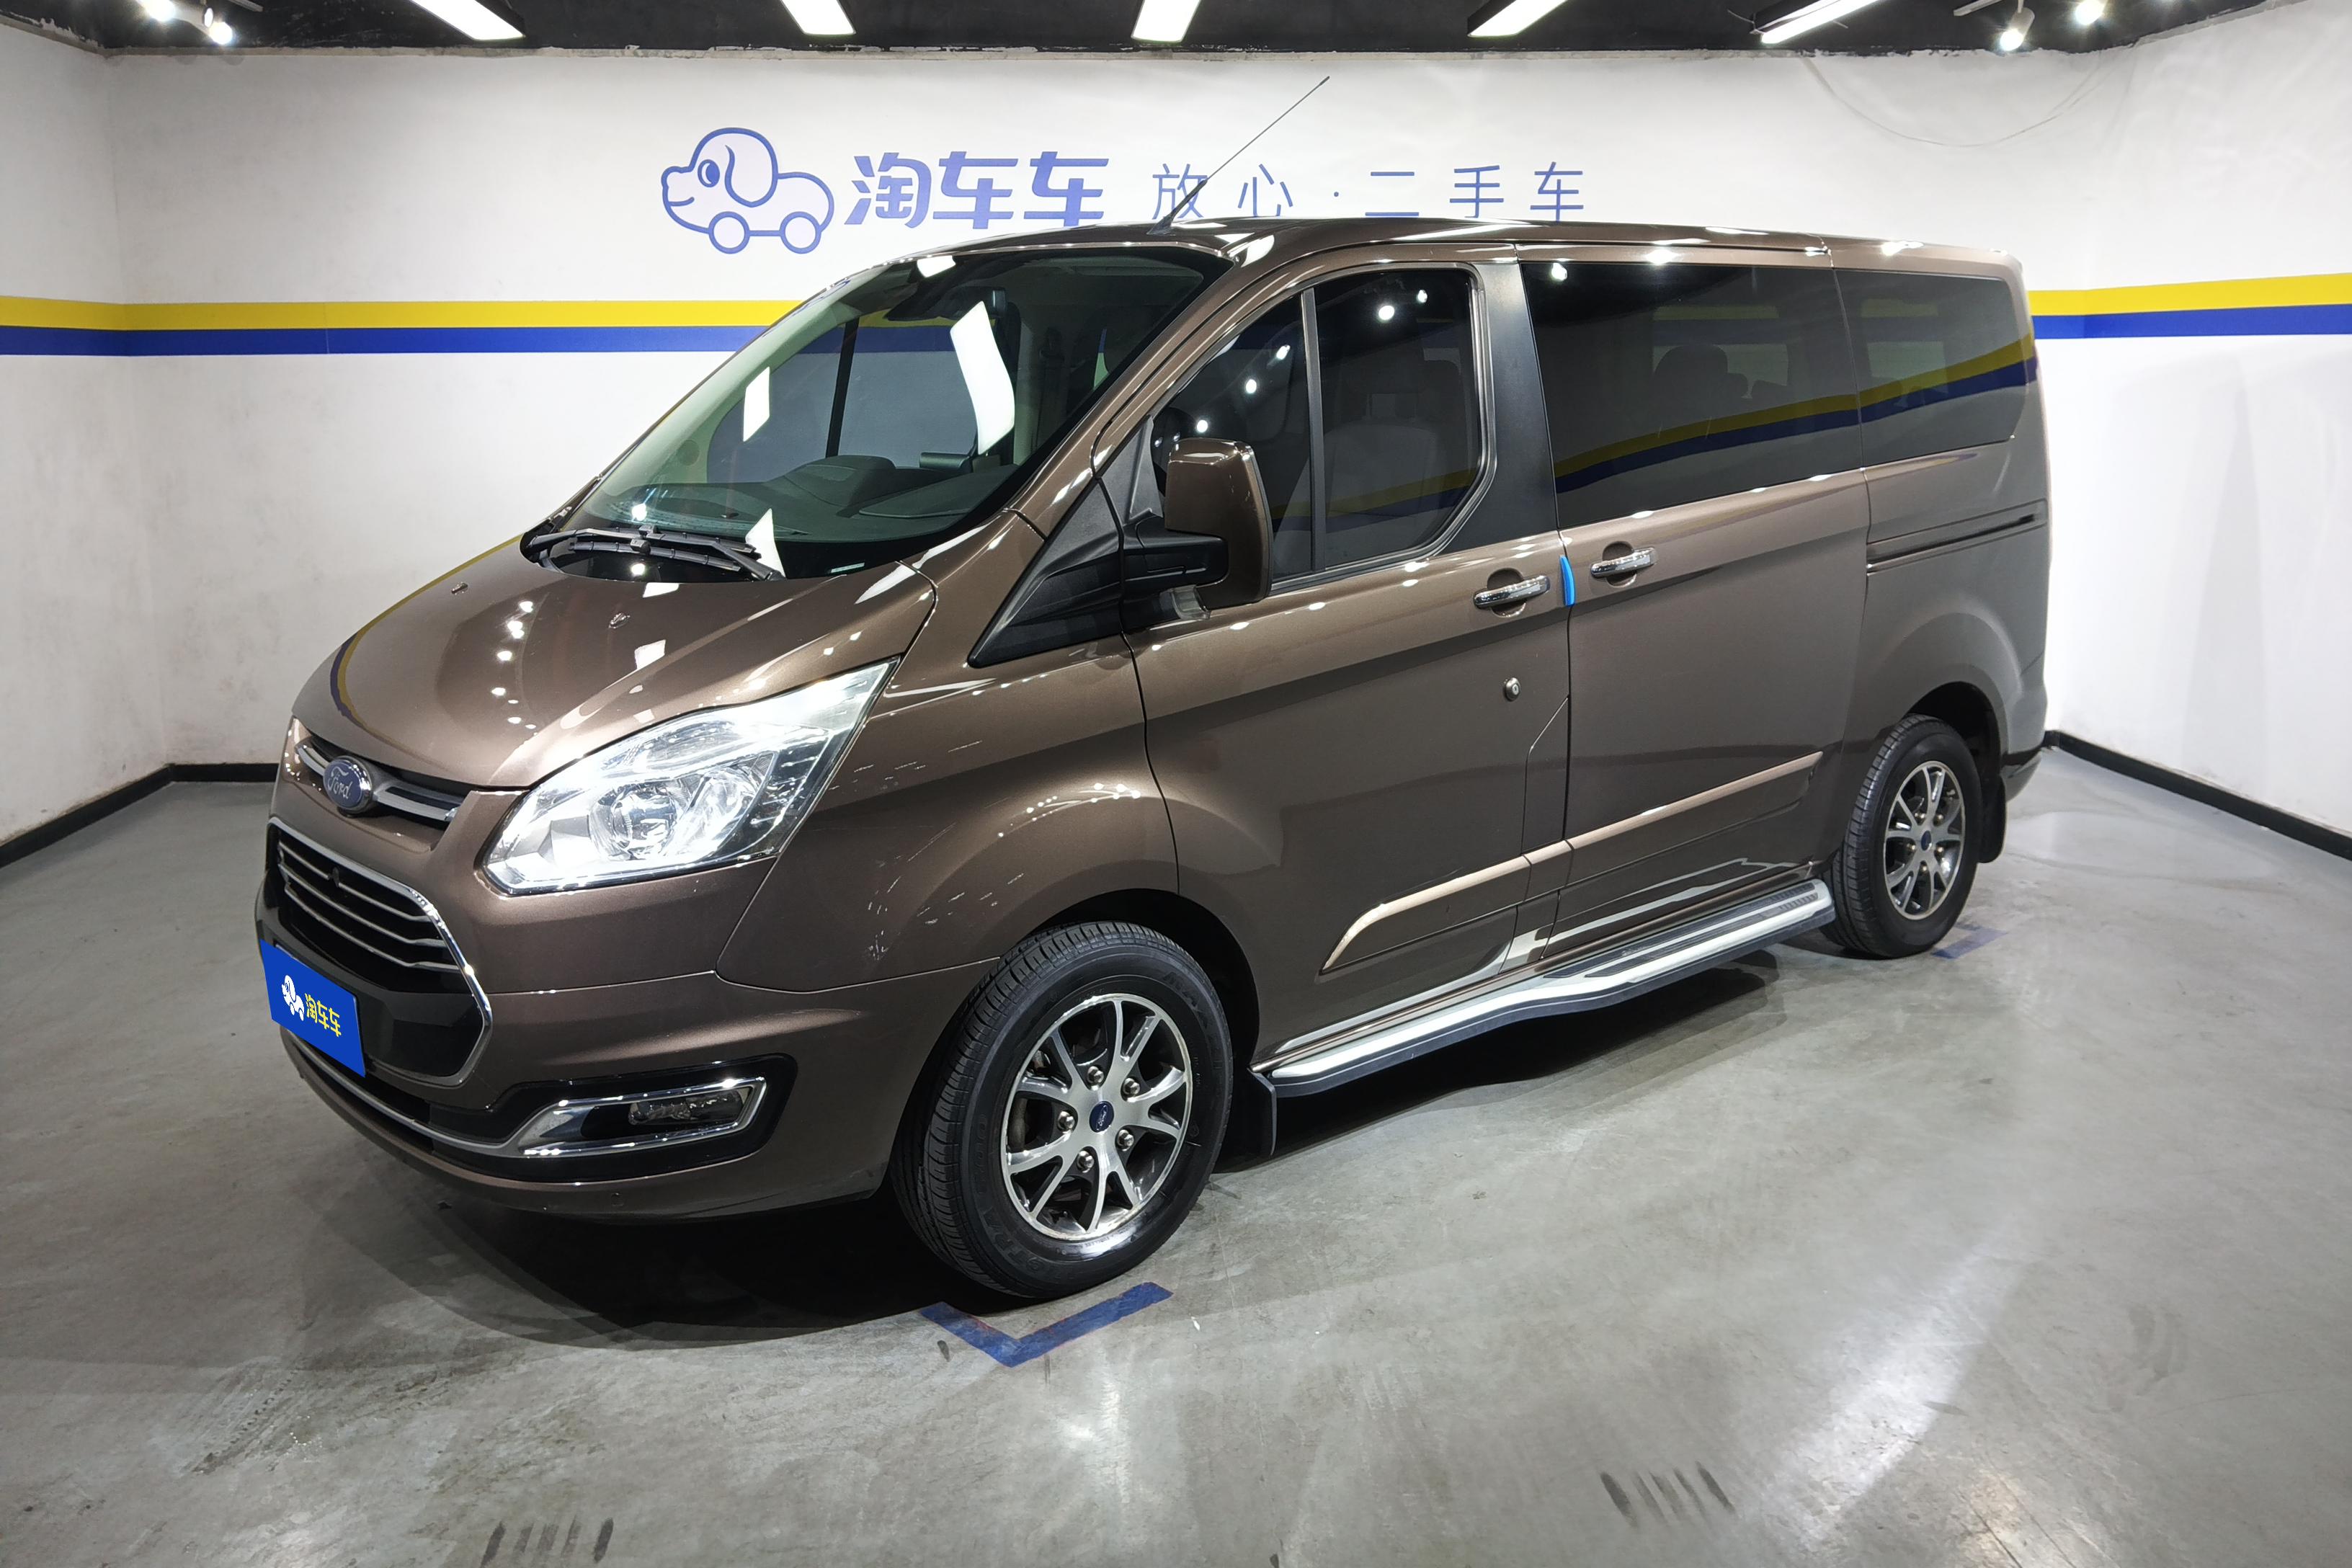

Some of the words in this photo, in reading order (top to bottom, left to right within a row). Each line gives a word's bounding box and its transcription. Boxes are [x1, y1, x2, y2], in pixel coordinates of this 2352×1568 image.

[844, 151, 1109, 229] 淘车车
[326, 766, 354, 800] Ford
